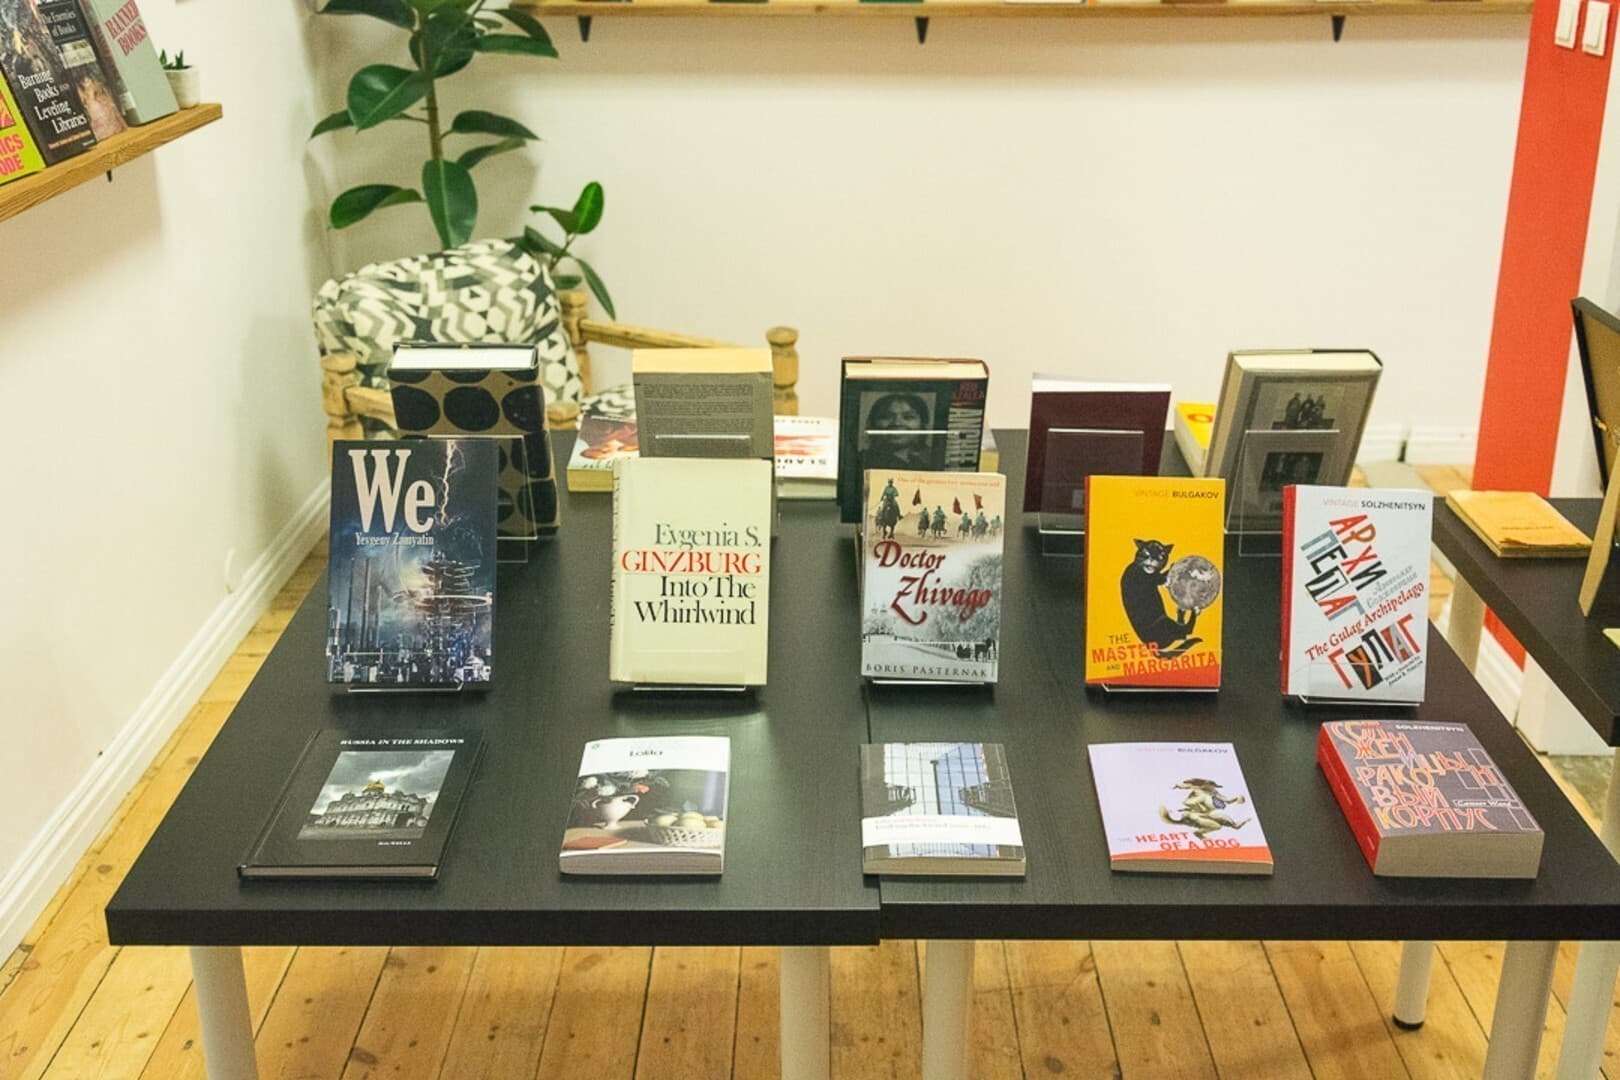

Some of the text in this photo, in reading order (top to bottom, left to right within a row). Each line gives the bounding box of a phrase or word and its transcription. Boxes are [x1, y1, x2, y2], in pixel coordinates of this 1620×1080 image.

[18, 70, 54, 89] Burning
[34, 83, 59, 103] Books
[51, 112, 87, 134] Libraries
[348, 449, 436, 533] We
[1171, 491, 1219, 499] BULGAKOV
[1360, 500, 1426, 511] SOLZHENITSYN
[355, 532, 434, 547] Yevgeny Zamyatin
[655, 522, 762, 551] Evgenia S.
[621, 550, 762, 574] GINZBURG
[874, 540, 946, 570] Doctor
[660, 574, 756, 599] Into The
[890, 569, 992, 625] Zhivago
[634, 599, 756, 625] Whirlwind
[1304, 582, 1425, 662] The Gulag Archipelago
[1108, 633, 1130, 644] THE
[1092, 641, 1160, 664] MASTER
[1123, 651, 1218, 676] MARGARITA
[866, 663, 987, 677] BORIS PASTERNAK
[1135, 832, 1189, 843] HEART
[1160, 838, 1241, 851] OF A DOG
